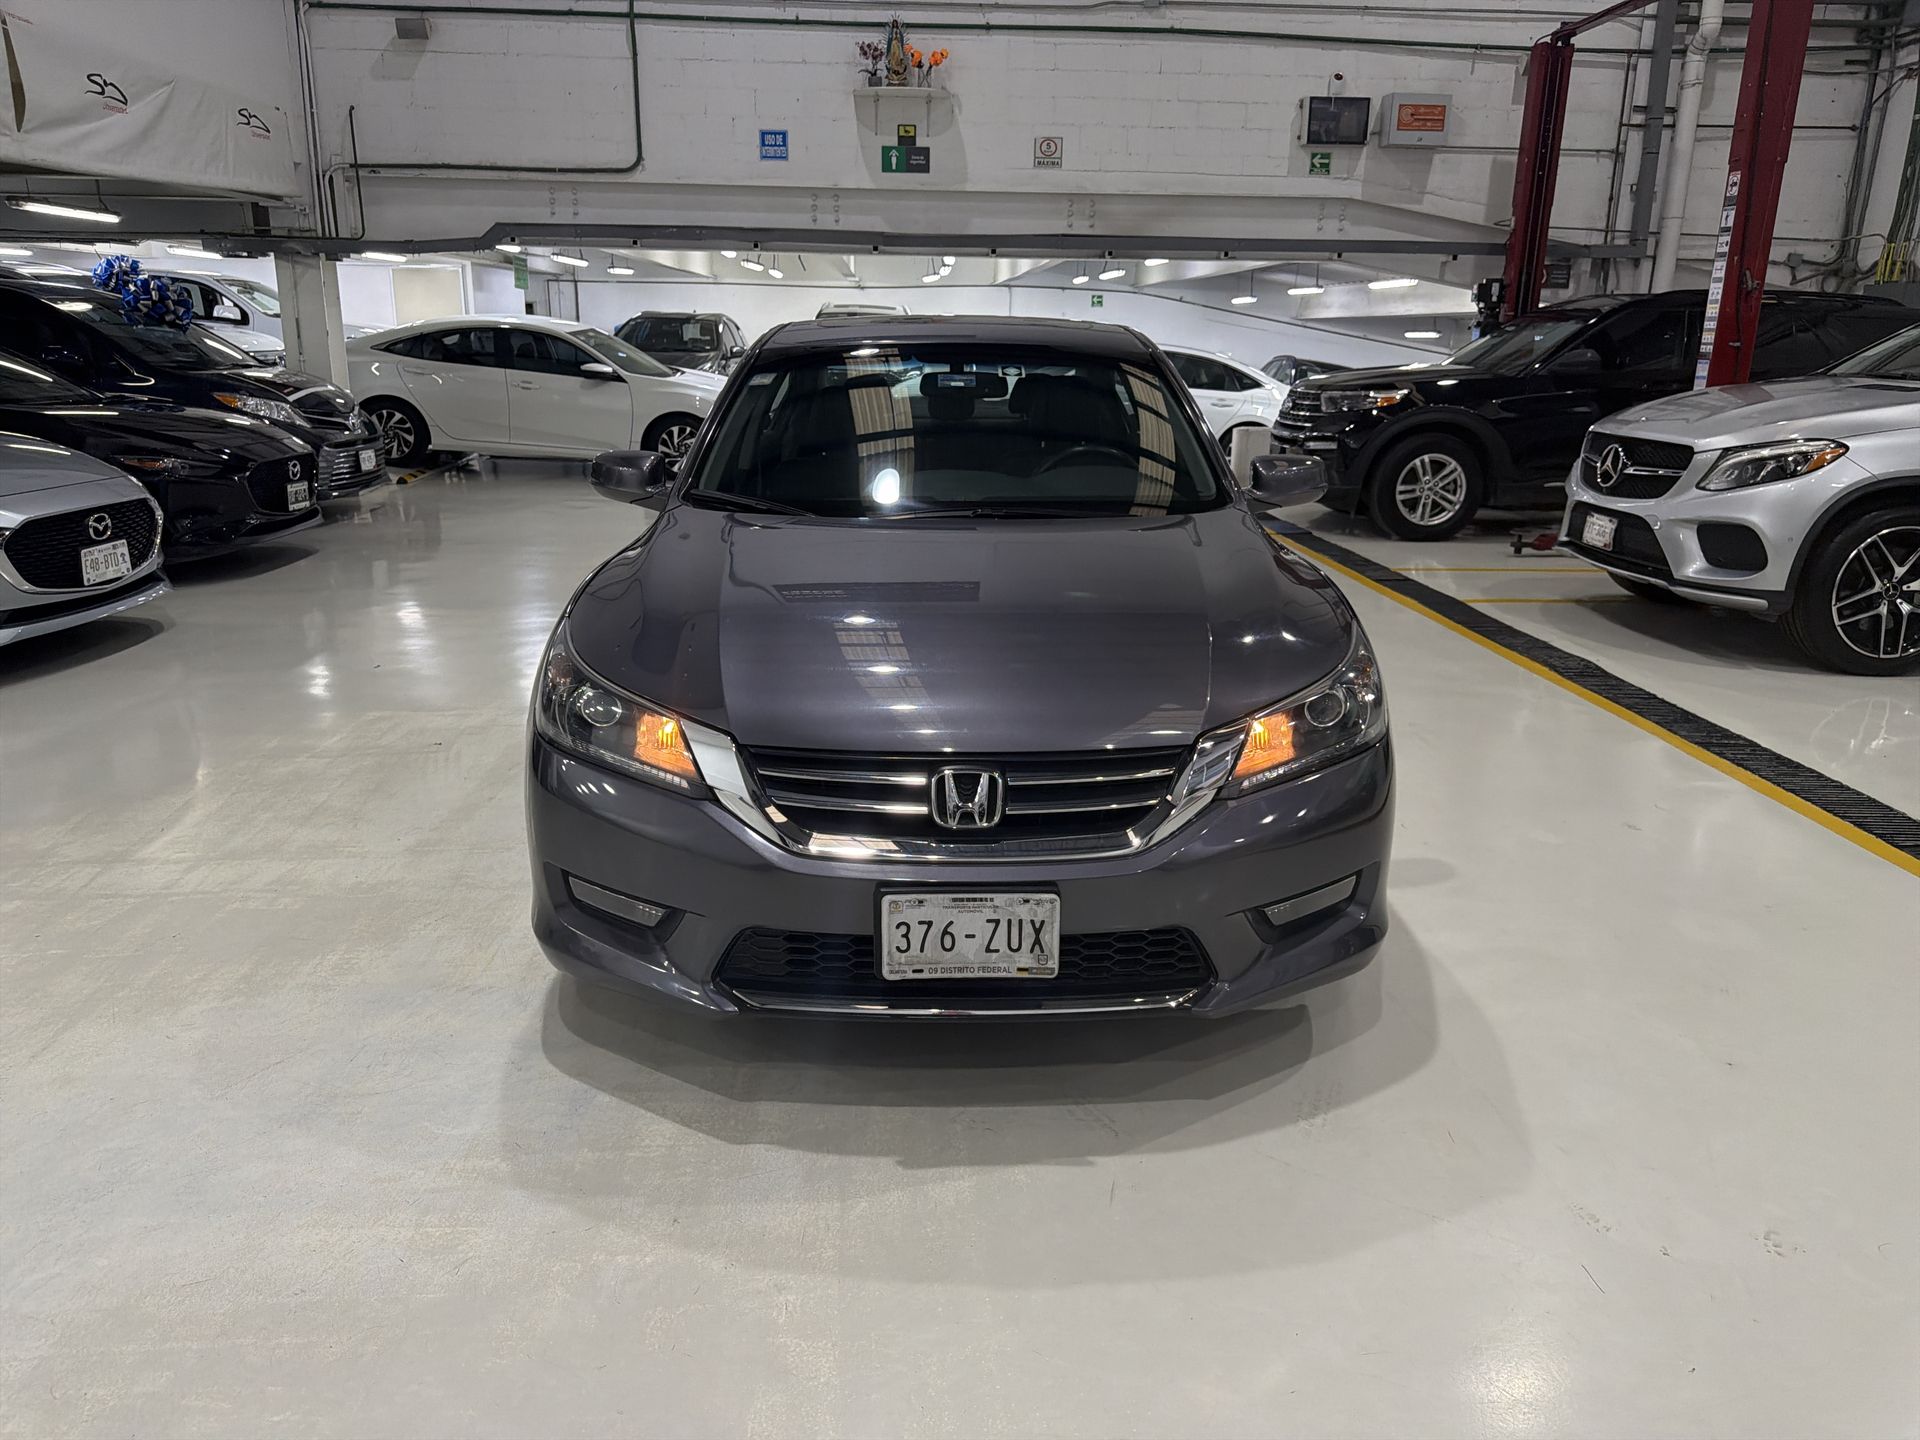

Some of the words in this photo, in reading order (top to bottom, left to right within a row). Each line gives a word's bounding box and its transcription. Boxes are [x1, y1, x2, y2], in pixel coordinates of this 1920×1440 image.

[895, 918, 1045, 953] 376-ZUX
[928, 967, 939, 975] 09
[940, 966, 976, 974] DISTRITO
[977, 965, 1012, 974] FEDERAL
